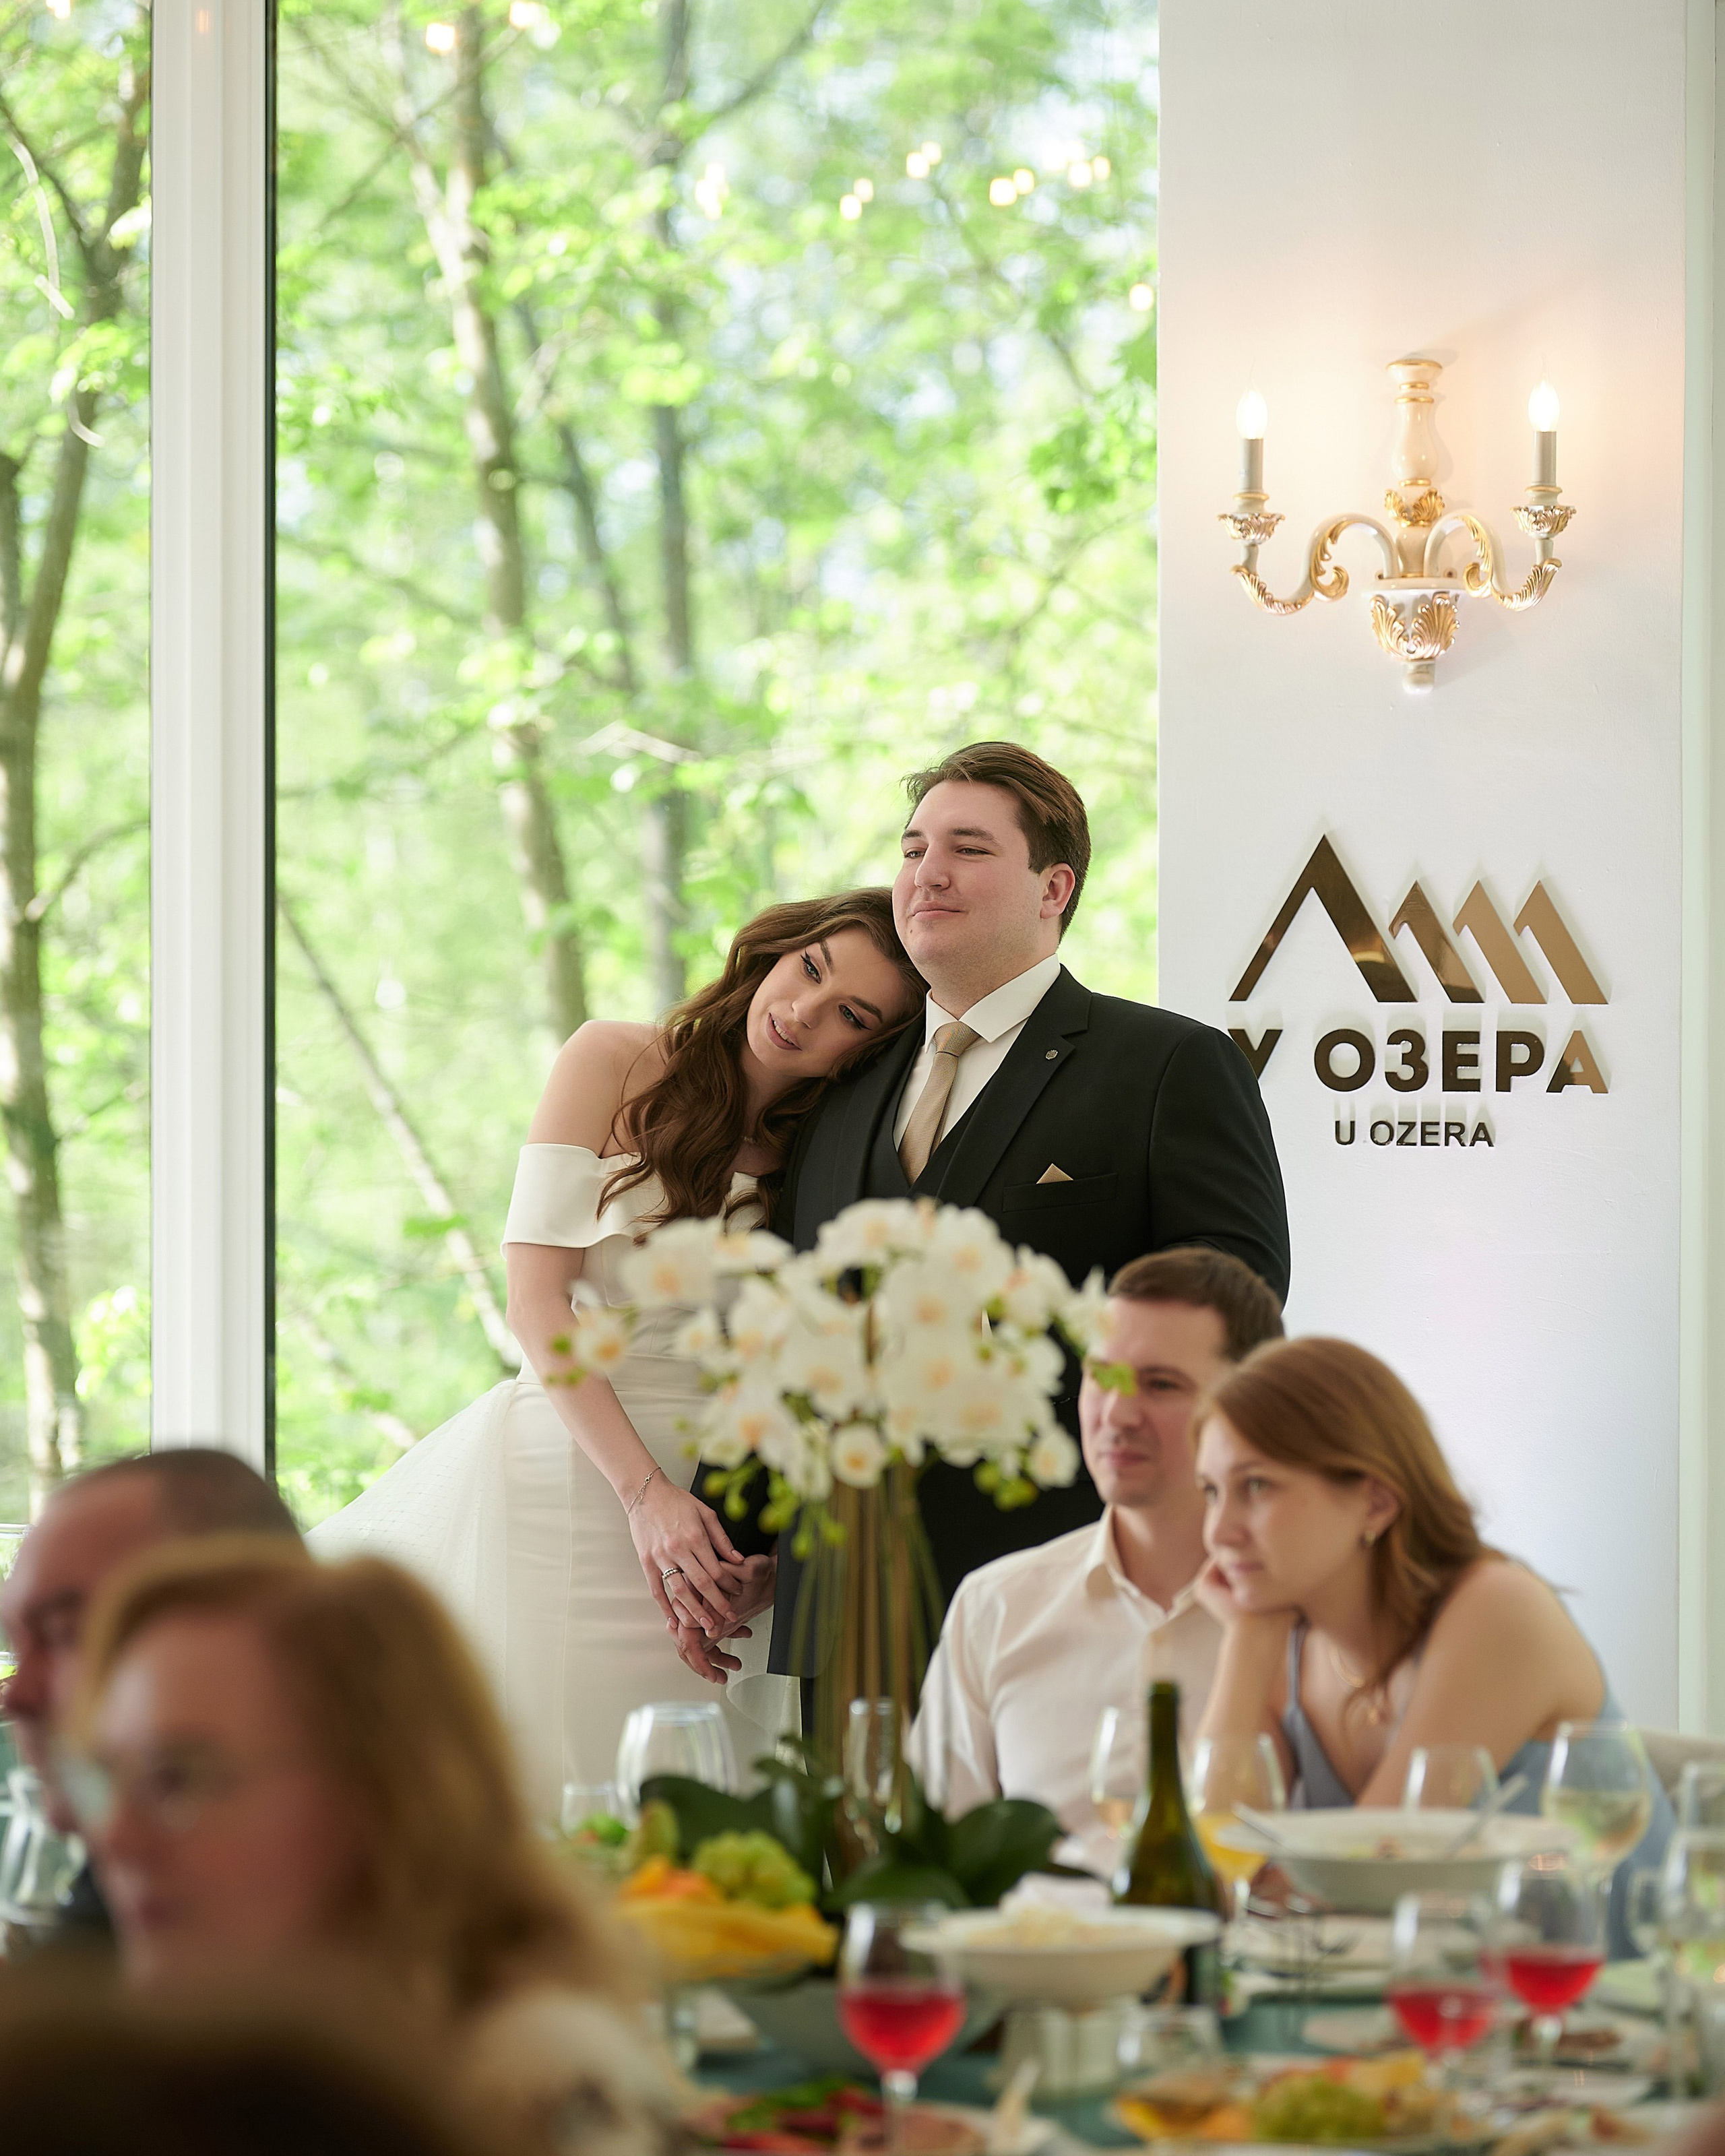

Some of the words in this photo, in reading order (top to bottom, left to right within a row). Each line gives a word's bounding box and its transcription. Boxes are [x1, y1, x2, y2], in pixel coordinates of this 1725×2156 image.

[1314, 1029, 1608, 1093] ОЗЕРА
[1335, 1120, 1355, 1145] U
[1370, 1120, 1494, 1147] OZERA
